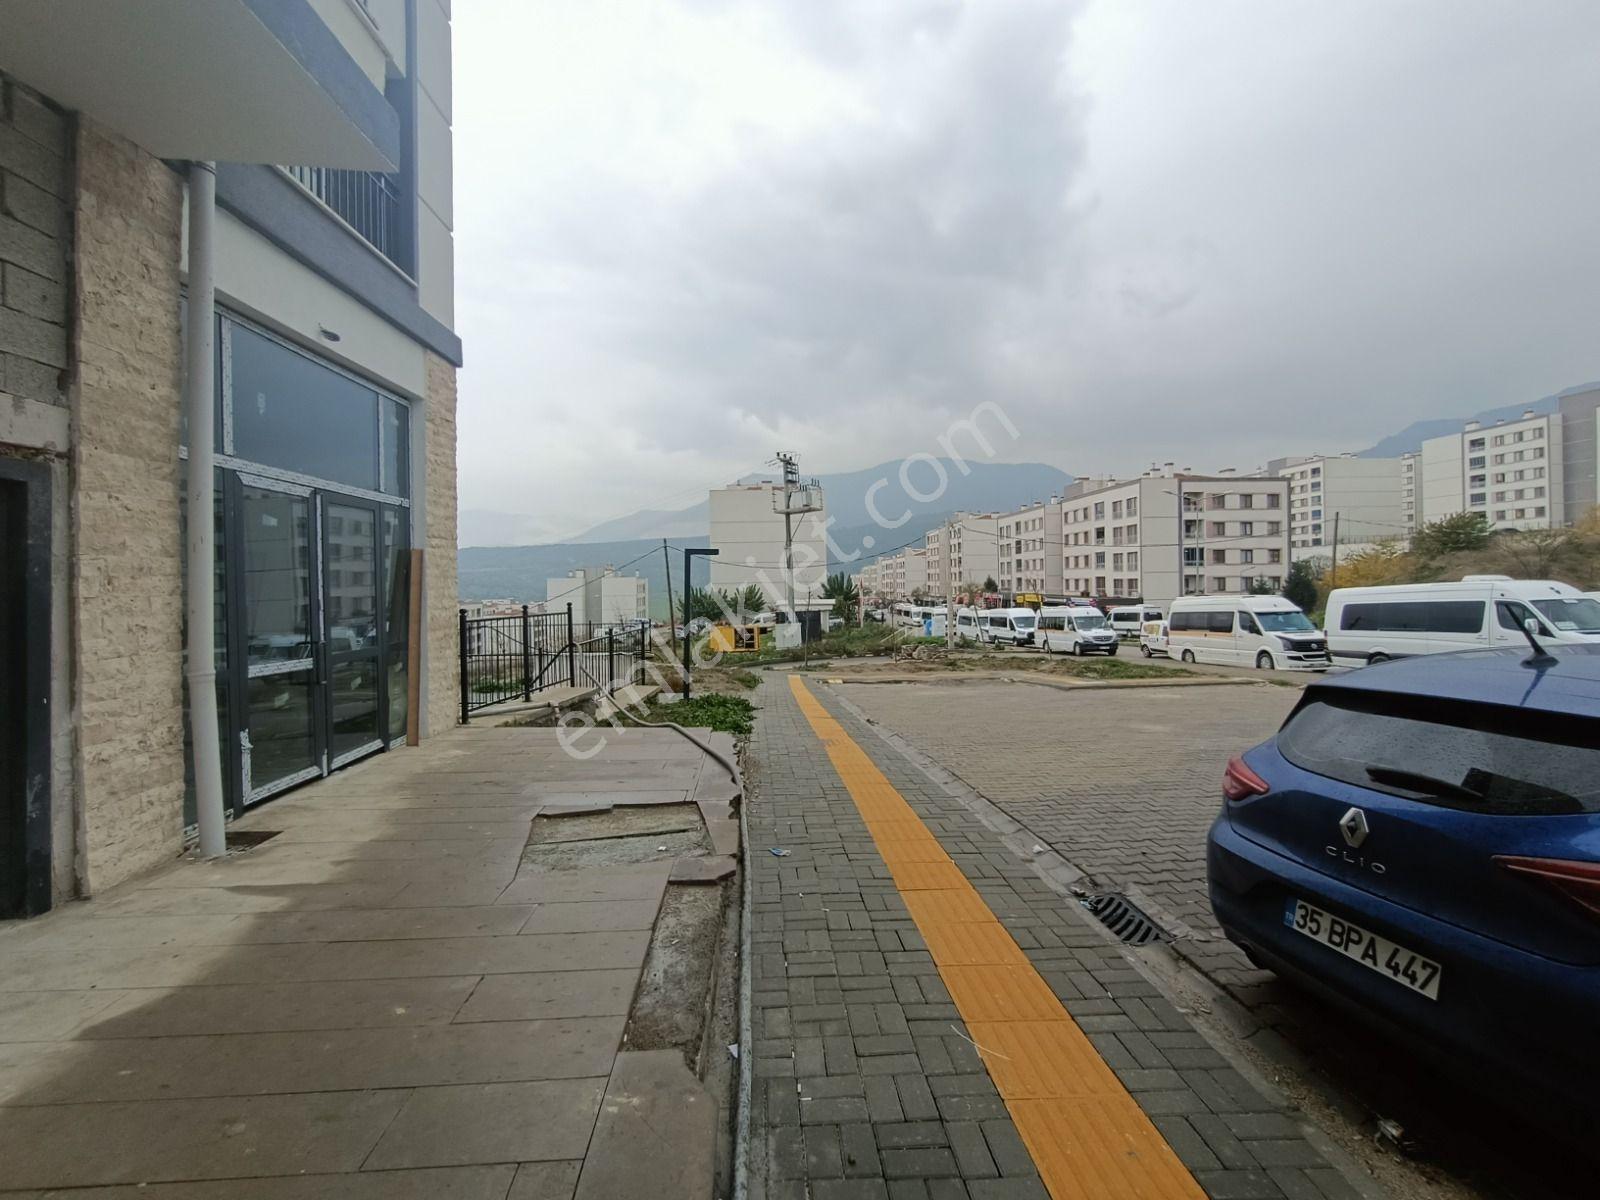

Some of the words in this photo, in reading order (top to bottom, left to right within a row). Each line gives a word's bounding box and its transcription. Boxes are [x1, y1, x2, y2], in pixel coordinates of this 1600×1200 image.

[1326, 845, 1386, 873] CLIO
[1295, 904, 1324, 936] 35
[1327, 918, 1378, 967] BPA
[1385, 947, 1440, 991] 447
